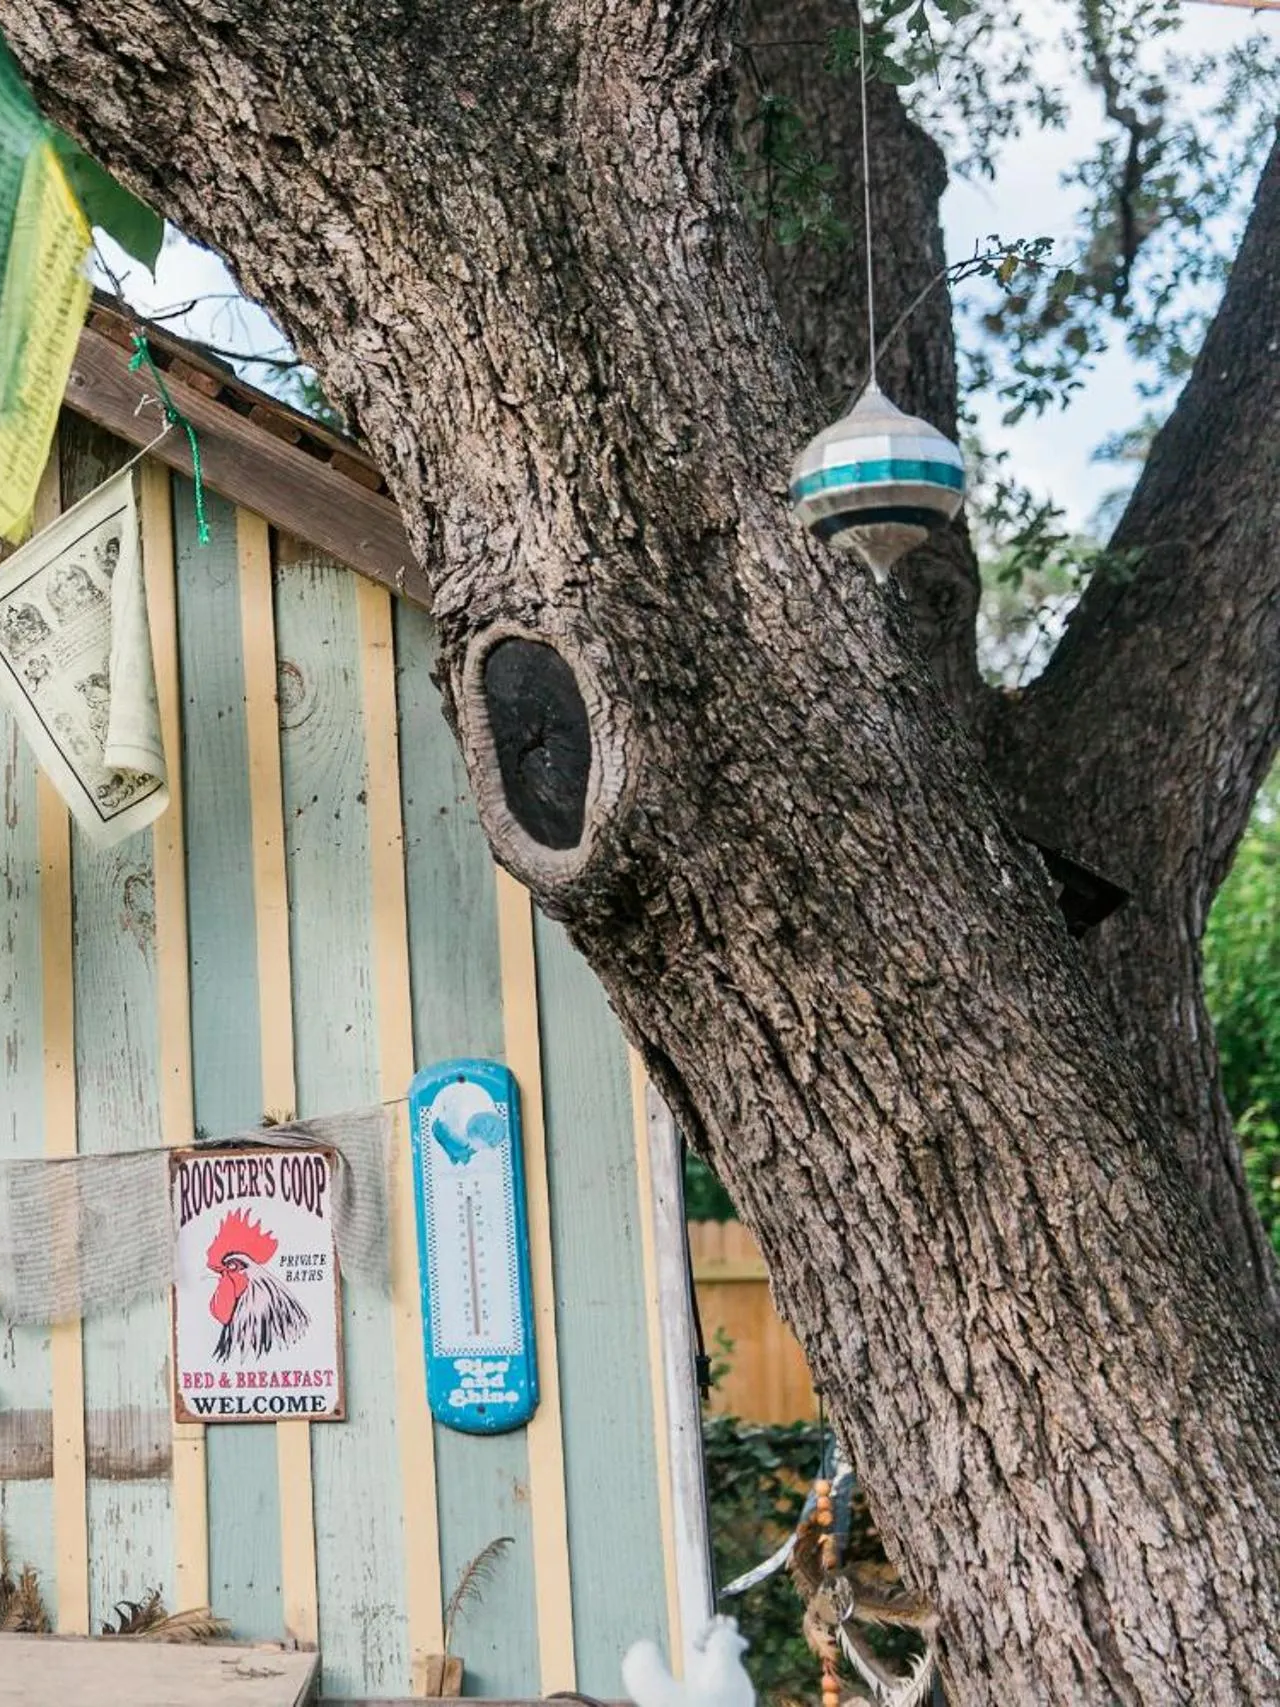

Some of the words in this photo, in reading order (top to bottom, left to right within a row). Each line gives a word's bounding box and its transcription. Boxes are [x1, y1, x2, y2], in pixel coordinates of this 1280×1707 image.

[179, 1156, 276, 1227] ROOSTER'S
[280, 1155, 326, 1218] COOP
[280, 1254, 327, 1267] PRIVATE
[286, 1270, 324, 1281] BATHS
[183, 1372, 213, 1389] BED
[220, 1372, 231, 1388] &
[236, 1370, 334, 1389] BREAKFAST
[191, 1395, 327, 1415] WELCOME
